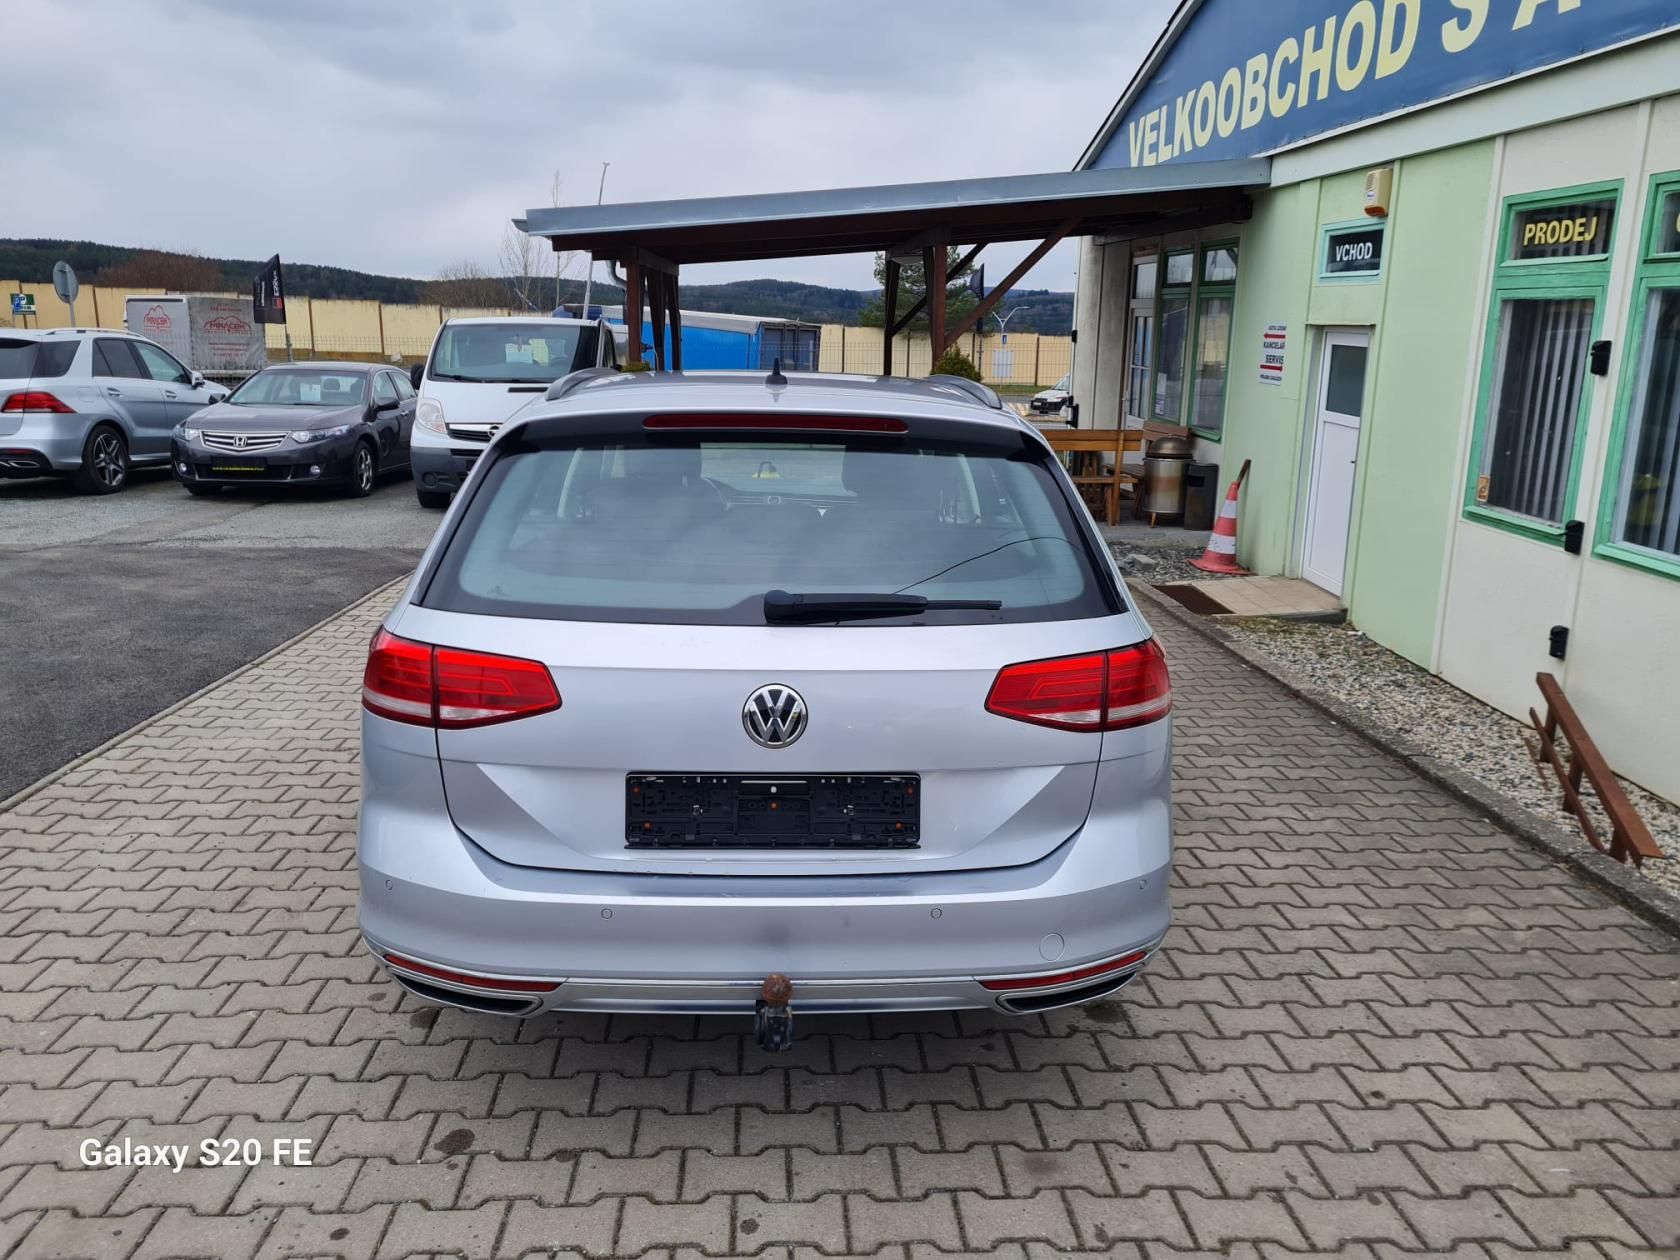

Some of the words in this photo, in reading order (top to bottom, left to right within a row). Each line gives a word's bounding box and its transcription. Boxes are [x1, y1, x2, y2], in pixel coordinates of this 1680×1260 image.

[1129, 0, 1421, 168] VELKOOBCHOD
[1523, 216, 1598, 246] PRODEJ
[1336, 242, 1373, 262] VCHOD
[1265, 354, 1284, 365] SERVIS
